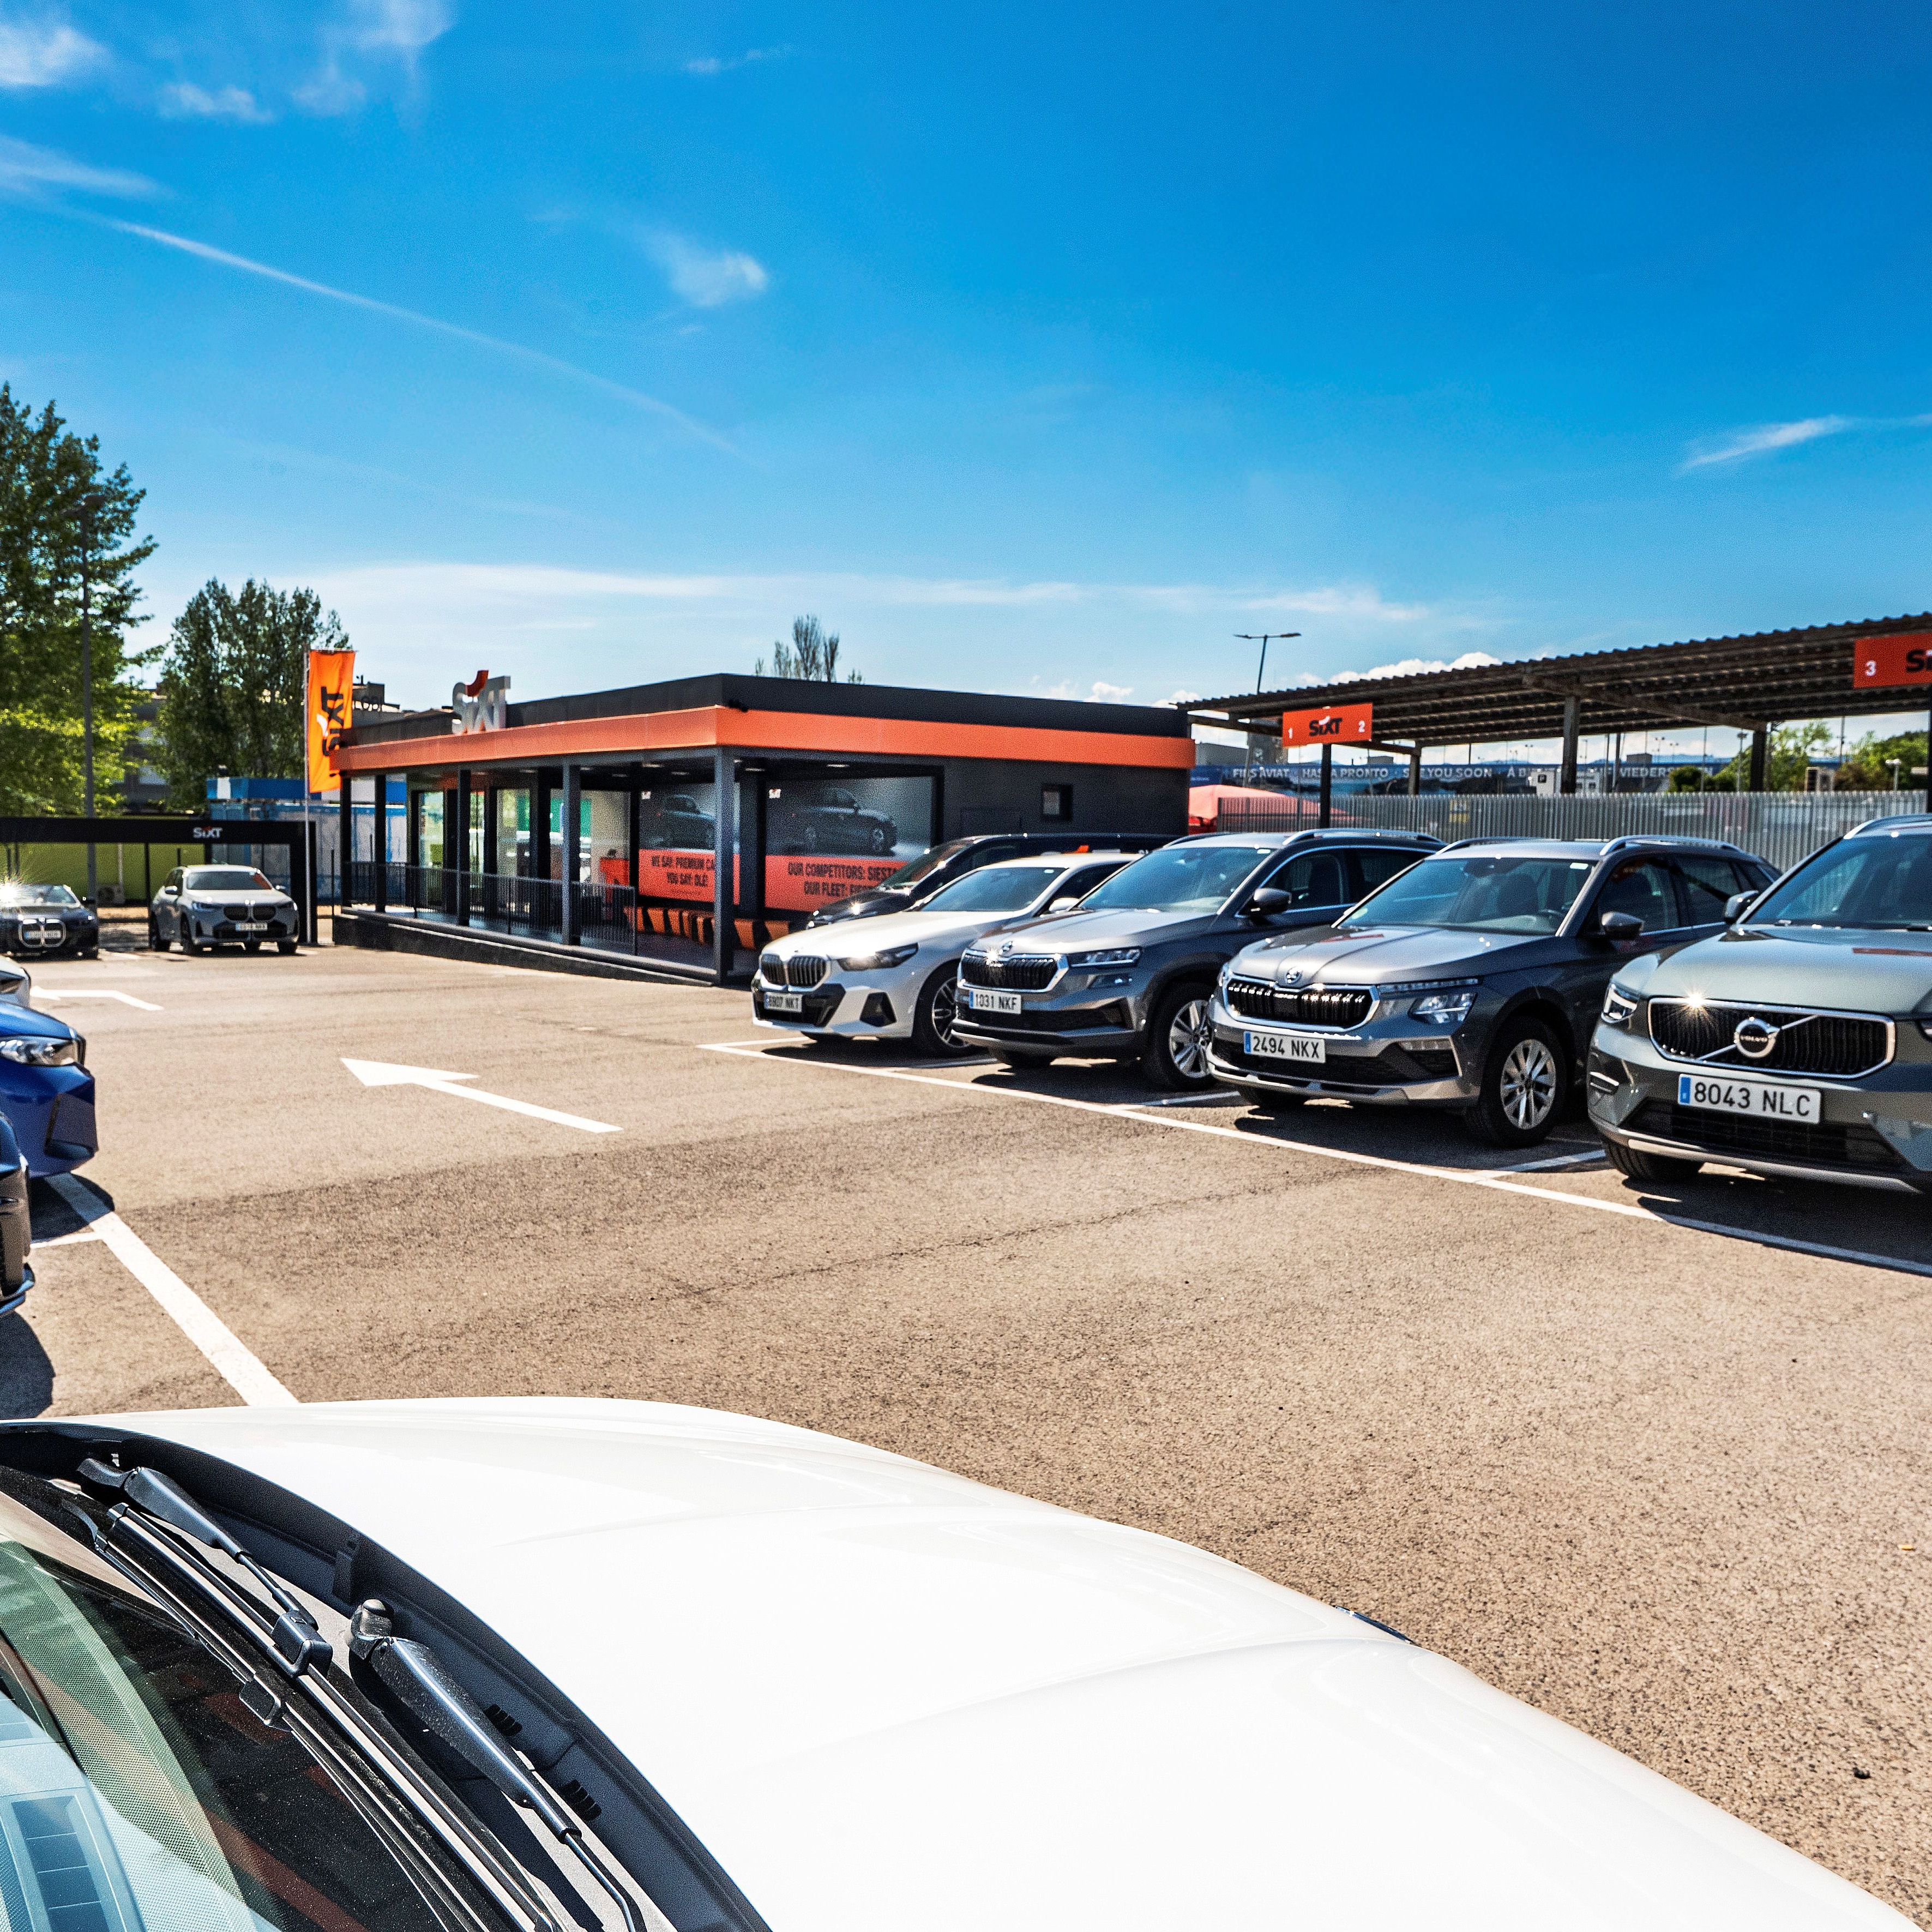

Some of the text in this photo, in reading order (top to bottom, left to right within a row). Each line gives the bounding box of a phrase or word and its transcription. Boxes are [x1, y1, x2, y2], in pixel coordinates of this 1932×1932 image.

[1865, 649, 1932, 677] 3 SI
[452, 670, 511, 735] SIXT
[1287, 715, 1365, 739] 1 SIXT 2
[1233, 768, 1257, 778] FIS
[1260, 768, 1289, 778] AVIAT
[1303, 768, 1338, 778] HASA
[1339, 768, 1388, 778] PRONTO
[1427, 767, 1452, 778] YOU
[1456, 767, 1492, 778] SOON
[193, 826, 223, 839] SIXT
[976, 994, 1017, 1010] 1031 NKF
[1253, 1036, 1320, 1058] 2494 NKX
[1694, 1082, 1810, 1116] 8043 NLC
